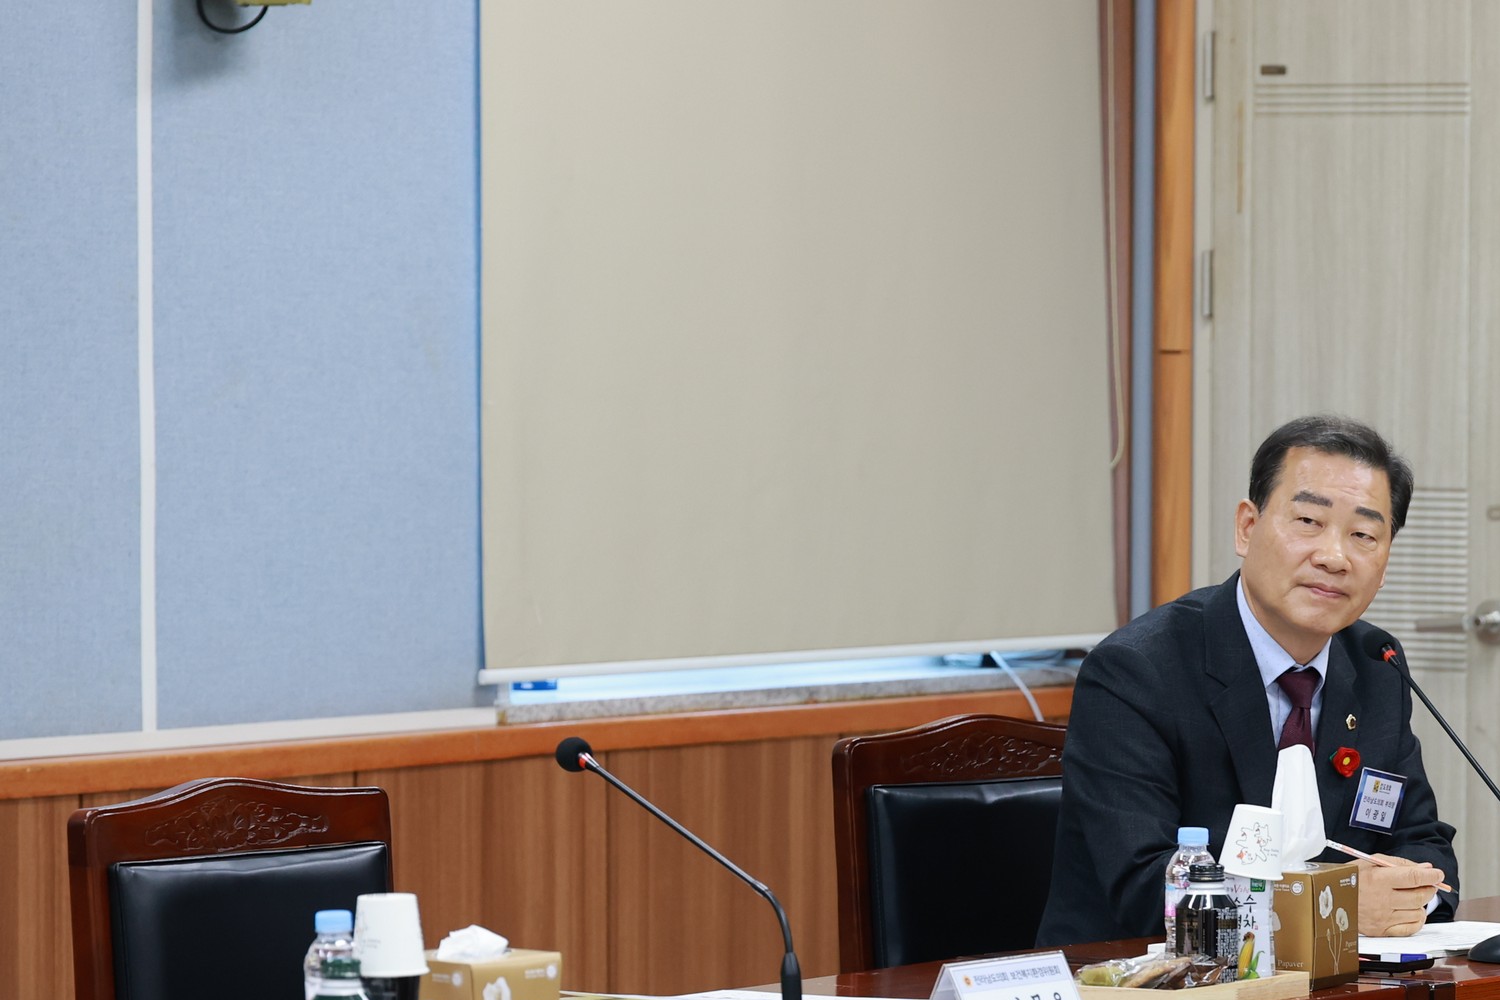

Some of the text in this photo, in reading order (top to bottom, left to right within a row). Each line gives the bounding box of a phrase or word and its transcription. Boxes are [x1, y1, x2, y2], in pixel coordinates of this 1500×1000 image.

[1277, 959, 1304, 968] Papaver
[973, 965, 1061, 986] 전라남도의회 보건복지환경위원회
